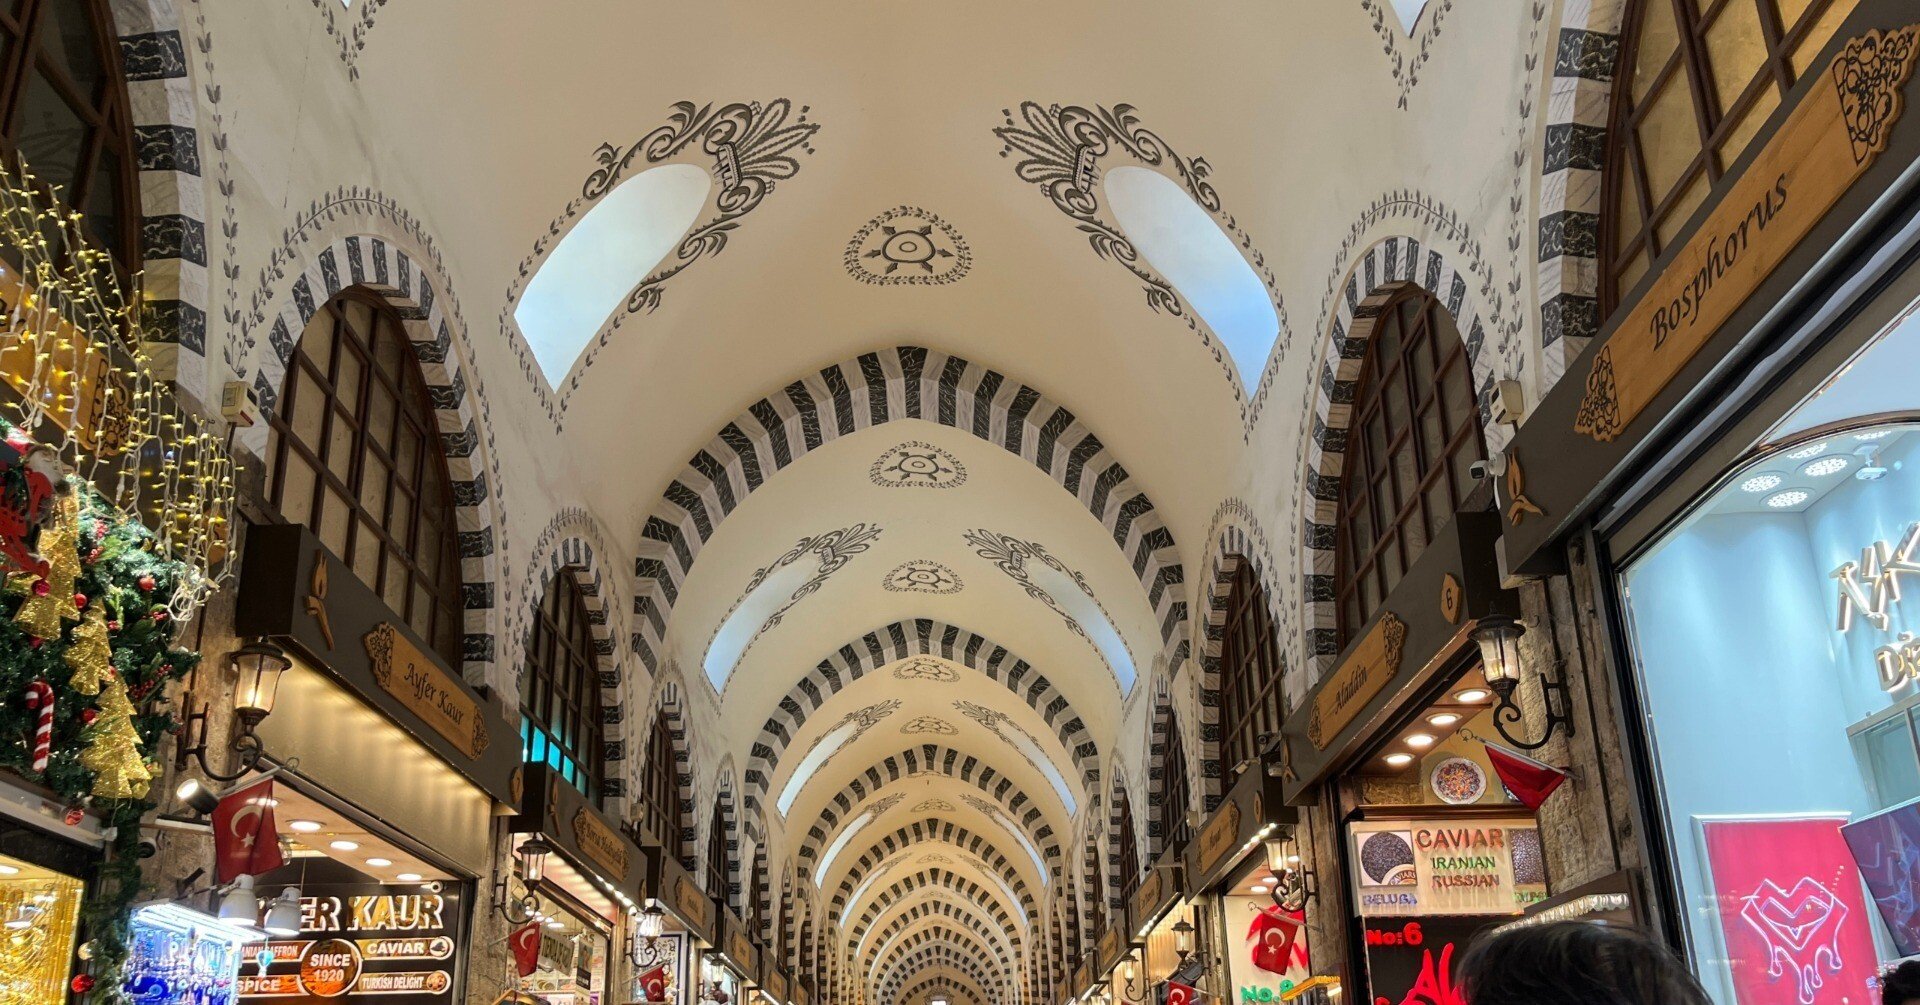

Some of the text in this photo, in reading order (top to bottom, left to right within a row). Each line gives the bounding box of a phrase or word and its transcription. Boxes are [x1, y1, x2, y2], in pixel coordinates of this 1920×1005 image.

[1650, 172, 1788, 351] Bosphorus
[1445, 587, 1453, 611] 6
[404, 662, 464, 726] Ayfer Kaur
[1334, 664, 1368, 715] Aladdin
[1416, 828, 1505, 849] CAVIAR
[1432, 856, 1496, 869] IRANIAN
[1432, 874, 1500, 888] RUSSIAN
[347, 894, 444, 931] KAUR
[1366, 922, 1424, 946] No:6
[266, 945, 298, 958] AFFRON
[367, 942, 424, 955] CAVIAR
[310, 954, 351, 967] SINCE
[313, 969, 344, 982] 1920
[362, 976, 424, 990] TURKISH DELIGHT
